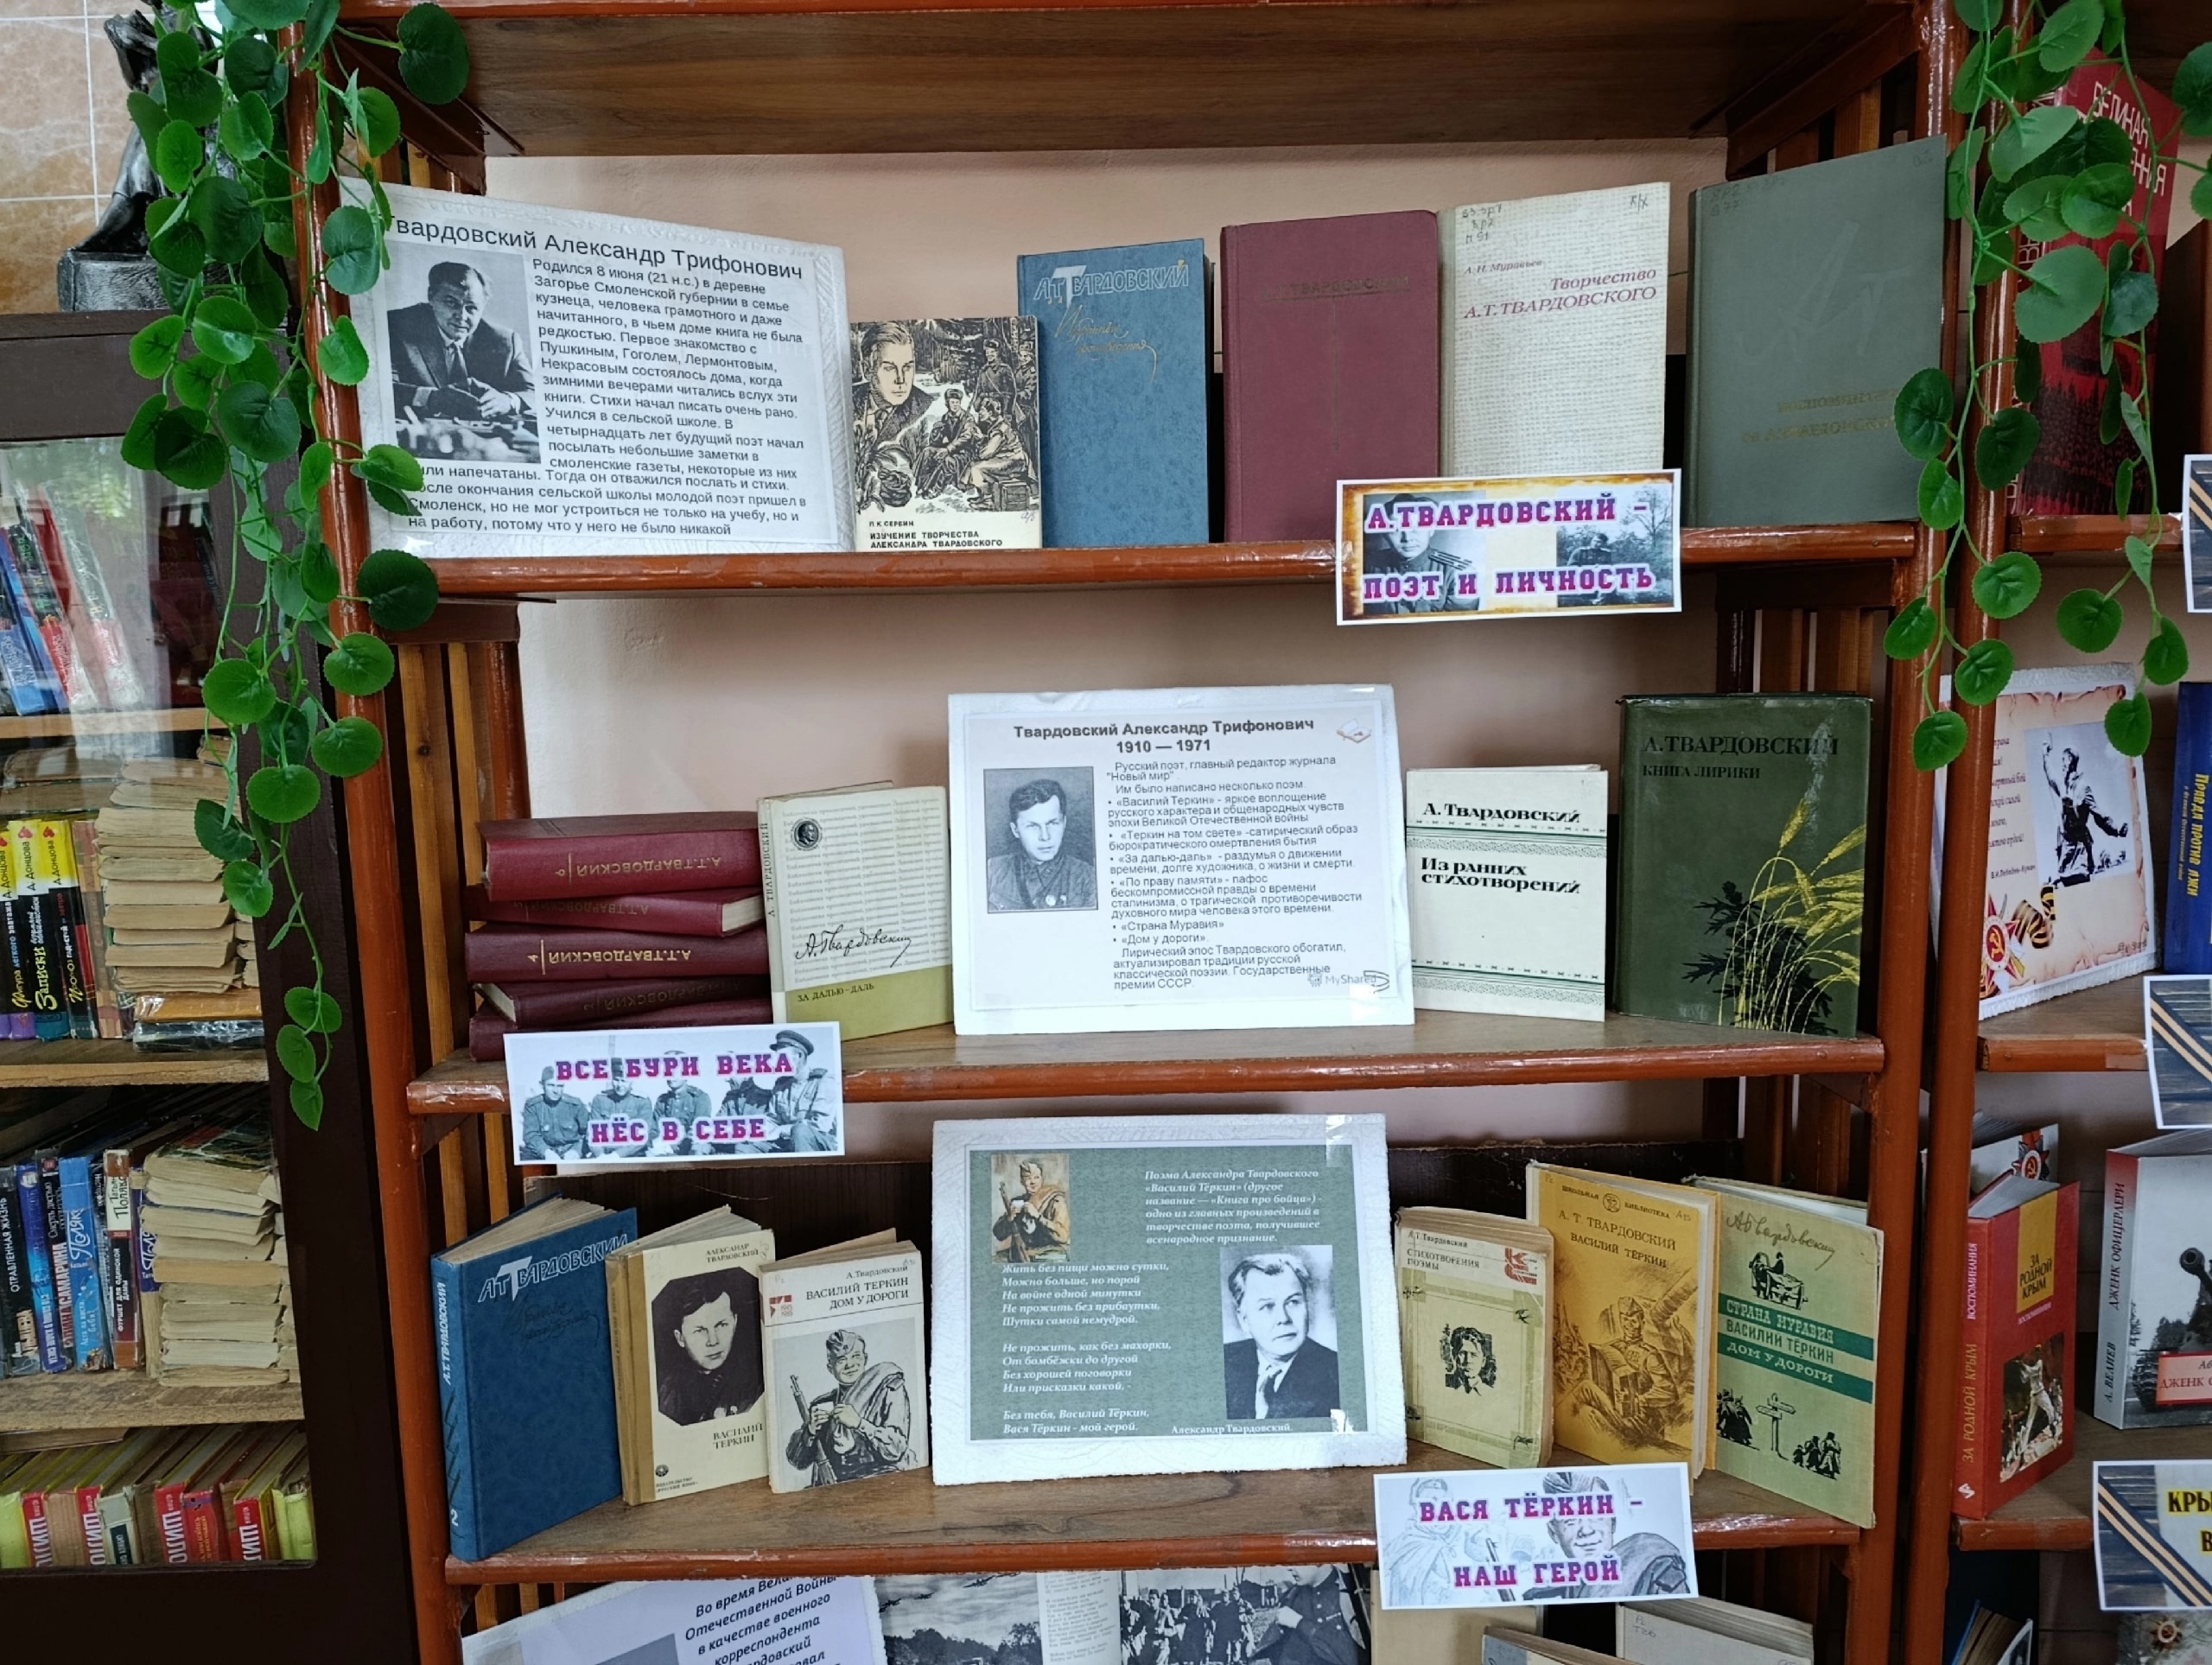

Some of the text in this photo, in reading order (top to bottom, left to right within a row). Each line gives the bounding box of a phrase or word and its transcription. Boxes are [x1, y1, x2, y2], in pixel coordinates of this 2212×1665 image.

[387, 215, 801, 277] вардовский Александр Трифонович
[532, 258, 592, 274] Родился
[596, 265, 605, 276] 8
[608, 269, 643, 280] июня
[647, 271, 668, 283] (21
[671, 276, 699, 289] н.с.)
[713, 281, 765, 294] деревне
[1550, 269, 1656, 290] Творчество
[534, 275, 588, 291] Загорье
[594, 282, 676, 299] Смоленской
[679, 292, 737, 305] губернии
[752, 300, 789, 311] семье
[1367, 493, 1616, 529] А.ТВАРДОВСКИЙ
[922, 531, 979, 539] ТВОРЧЕСТВА
[932, 539, 1003, 548] ТВАРДОВСКОГО
[1363, 567, 1653, 600] ПОЭТ И ЛИЧНОСТЬ
[1014, 720, 1313, 739] Твардовский Александр Трифонович
[1116, 740, 1151, 753] 1910
[1176, 739, 1210, 751] 1971
[1115, 757, 1336, 772] Русский поэт, главный редактор журнала
[1643, 765, 1760, 778] КНИГА ЛИРИКИ
[1423, 803, 1580, 823] А. Твардовский
[2189, 823, 2203, 866] ПРОТИВ
[577, 856, 721, 877] А.Т.ТВАРДОВСКИЙ
[761, 823, 774, 902] ТВАРДОВСКИЙ
[1421, 857, 1527, 876] Из ранних
[1421, 874, 1580, 893] стихотворений
[2187, 868, 2200, 896] ЛЖИ
[549, 950, 691, 963] А.Т.ТВАРДОВСКИЙ
[798, 994, 810, 1002] ЗА
[556, 1053, 793, 1081] ВСЕ БУРИ ВЕКА
[592, 1117, 765, 1143] НЁС В СЕБЕ
[1144, 1168, 1319, 1180] Поэма Александра Твардовского
[1561, 1185, 1670, 1219] ШКОЛЬНАЯ БИБЛИОТЕКА
[1558, 1210, 1570, 1220] А.
[1586, 1217, 1676, 1251] ТВАРДОВСКИЙ
[707, 1243, 750, 1255] АЛЕКСАНДР
[1407, 1248, 1480, 1268] СТИХОТВОРЕНИЯ
[1570, 1232, 1667, 1268] ВАСИЛИЙ ТЁРКИН
[2030, 1254, 2040, 1268] ЗА
[2108, 1184, 2125, 1311] ДЖЕНК ОФИЦЕРЛЕРИ
[3, 1231, 20, 1293] ОТРАВЛЕННАЯ
[1001, 1262, 1036, 1274] Жить
[1038, 1261, 1056, 1271] без
[1058, 1261, 1088, 1274] пищи
[1131, 1263, 1168, 1274] сутки,
[1408, 1259, 1440, 1270] ПОЭМЫ
[2019, 1257, 2052, 1287] РОДНОЙ
[806, 1276, 908, 1300] ВАСИЛИЙ ТЕРКИН
[1967, 1242, 1978, 1320] ВОСПОМИНАНИЯ
[2022, 1277, 2046, 1300] КРЫМ
[830, 1289, 908, 1311] ДОМ У ДОРОГИ
[1726, 1299, 1834, 1344] СТРАНА МУРАВИЯ
[1727, 1319, 1834, 1364] ВАСИЛИЙ ТЁРКИН
[1727, 1342, 1834, 1384] ДОМ У ДОРОГИ
[2104, 1342, 2116, 1389] ВЕЛИЕВ
[2159, 1377, 2205, 1389] ДЖЕНК
[1962, 1343, 1978, 1463] ЗА РОДНОЙ КРЫМ
[714, 1423, 763, 1440] ВАСИЛИЙ
[714, 1435, 754, 1449] ТЕРКИН
[451, 1509, 459, 1526] 2
[1420, 1500, 1489, 1522] ВАСЯ
[1504, 1492, 1614, 1518] ТЁРКИН
[1454, 1553, 1619, 1588] НАШ ГЕРОЙ
[685, 1588, 792, 1641] Отечественной
[696, 1586, 755, 1617] Во время
[698, 1645, 706, 1655] в
[709, 1617, 771, 1650] качестве
[773, 1593, 831, 1624] военного
[715, 1616, 821, 1665] корреспондента
